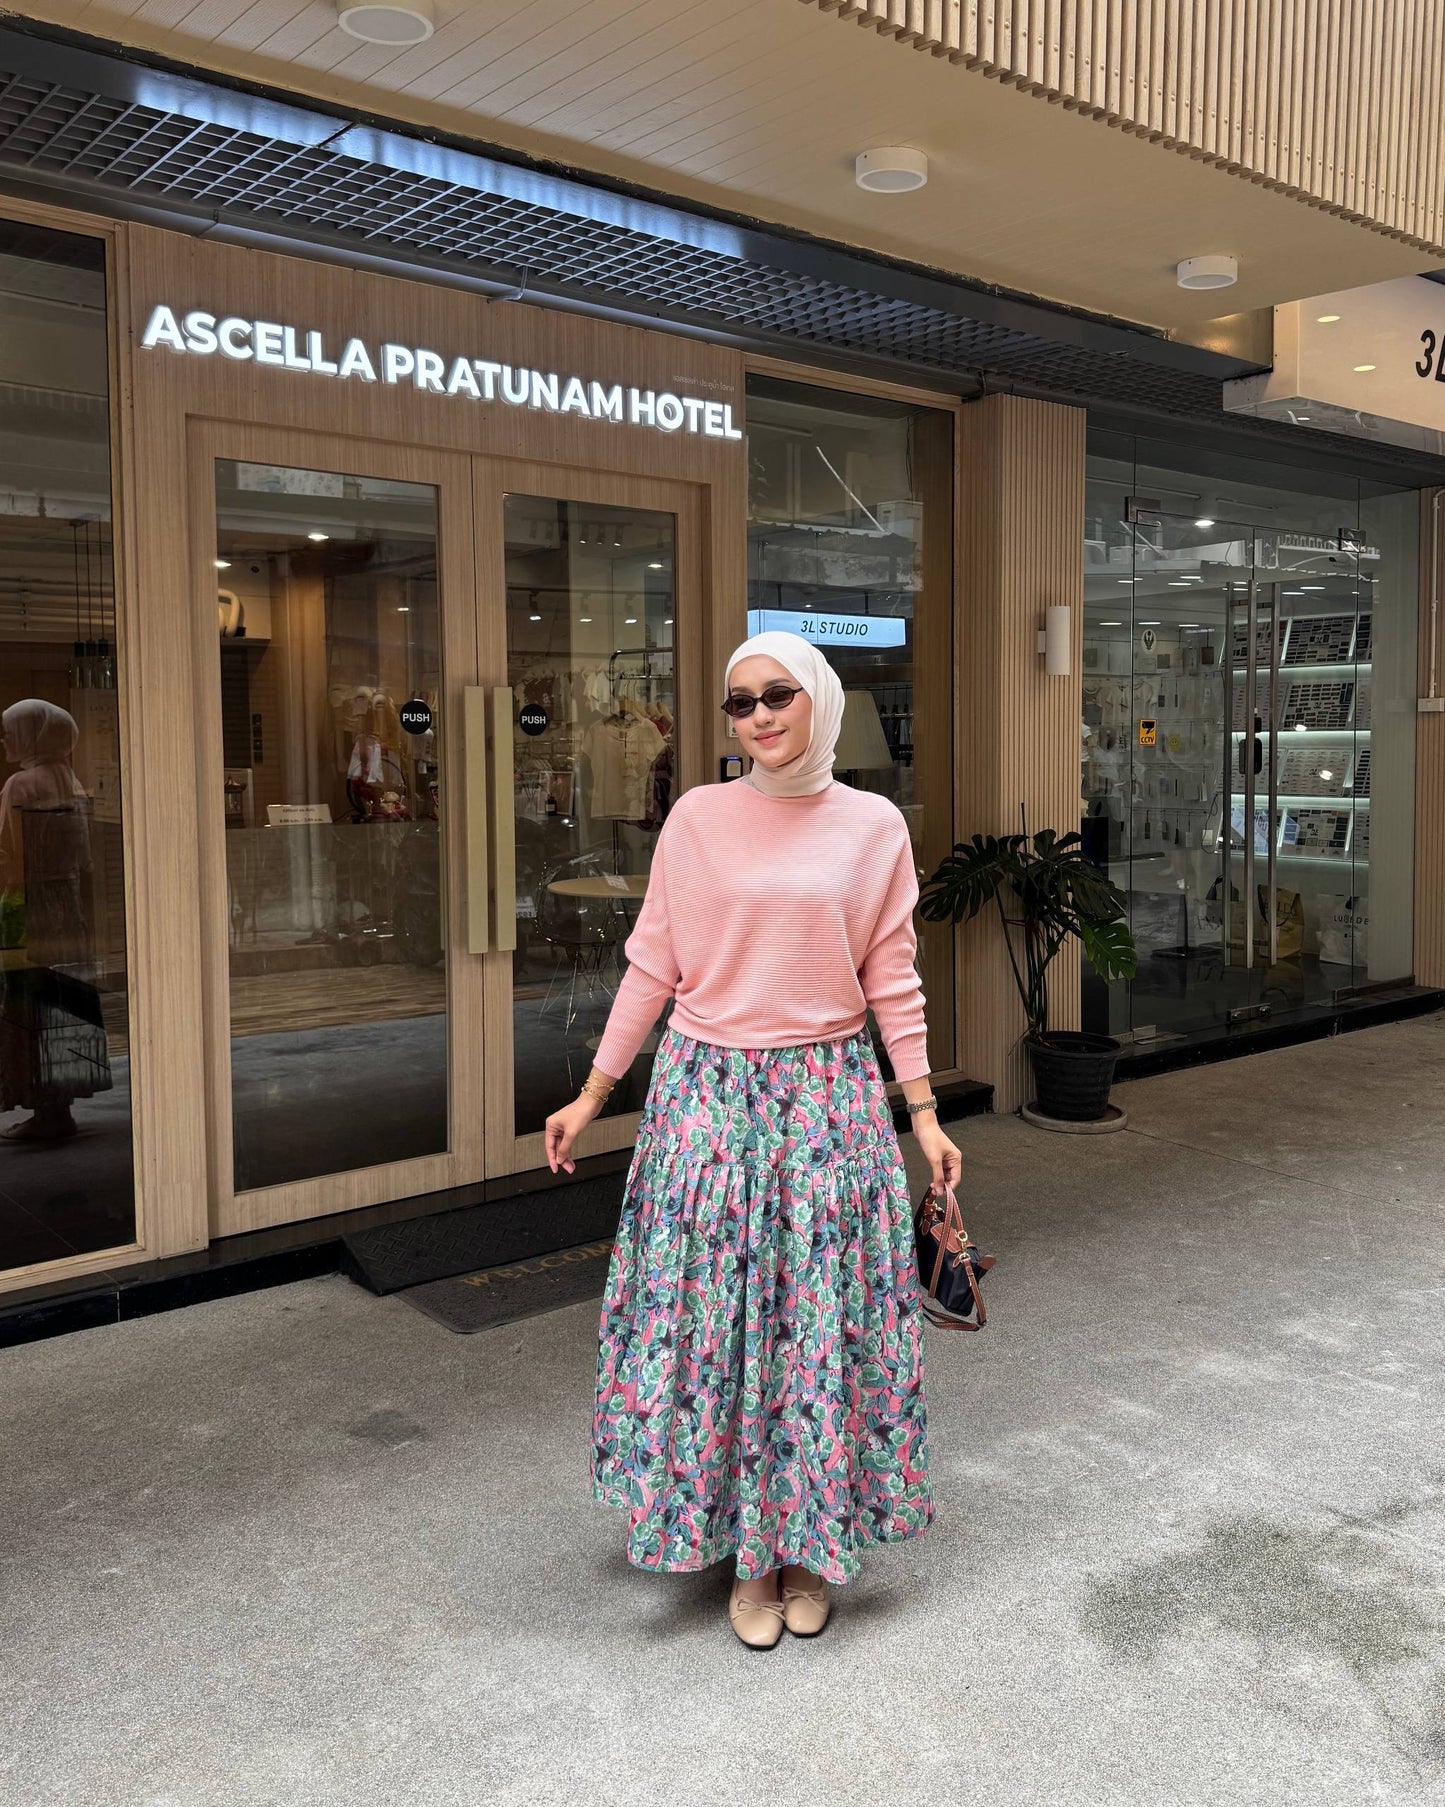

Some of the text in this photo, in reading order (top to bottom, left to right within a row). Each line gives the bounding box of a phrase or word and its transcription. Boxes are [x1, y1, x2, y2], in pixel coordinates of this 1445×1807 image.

[141, 304, 742, 440] ASCELLA PRATUNAM HOTEL
[801, 620, 868, 635] 3L STUDIO
[402, 713, 430, 723] PUSH
[521, 716, 546, 724] PUSH
[460, 1242, 613, 1287] WELCOM
